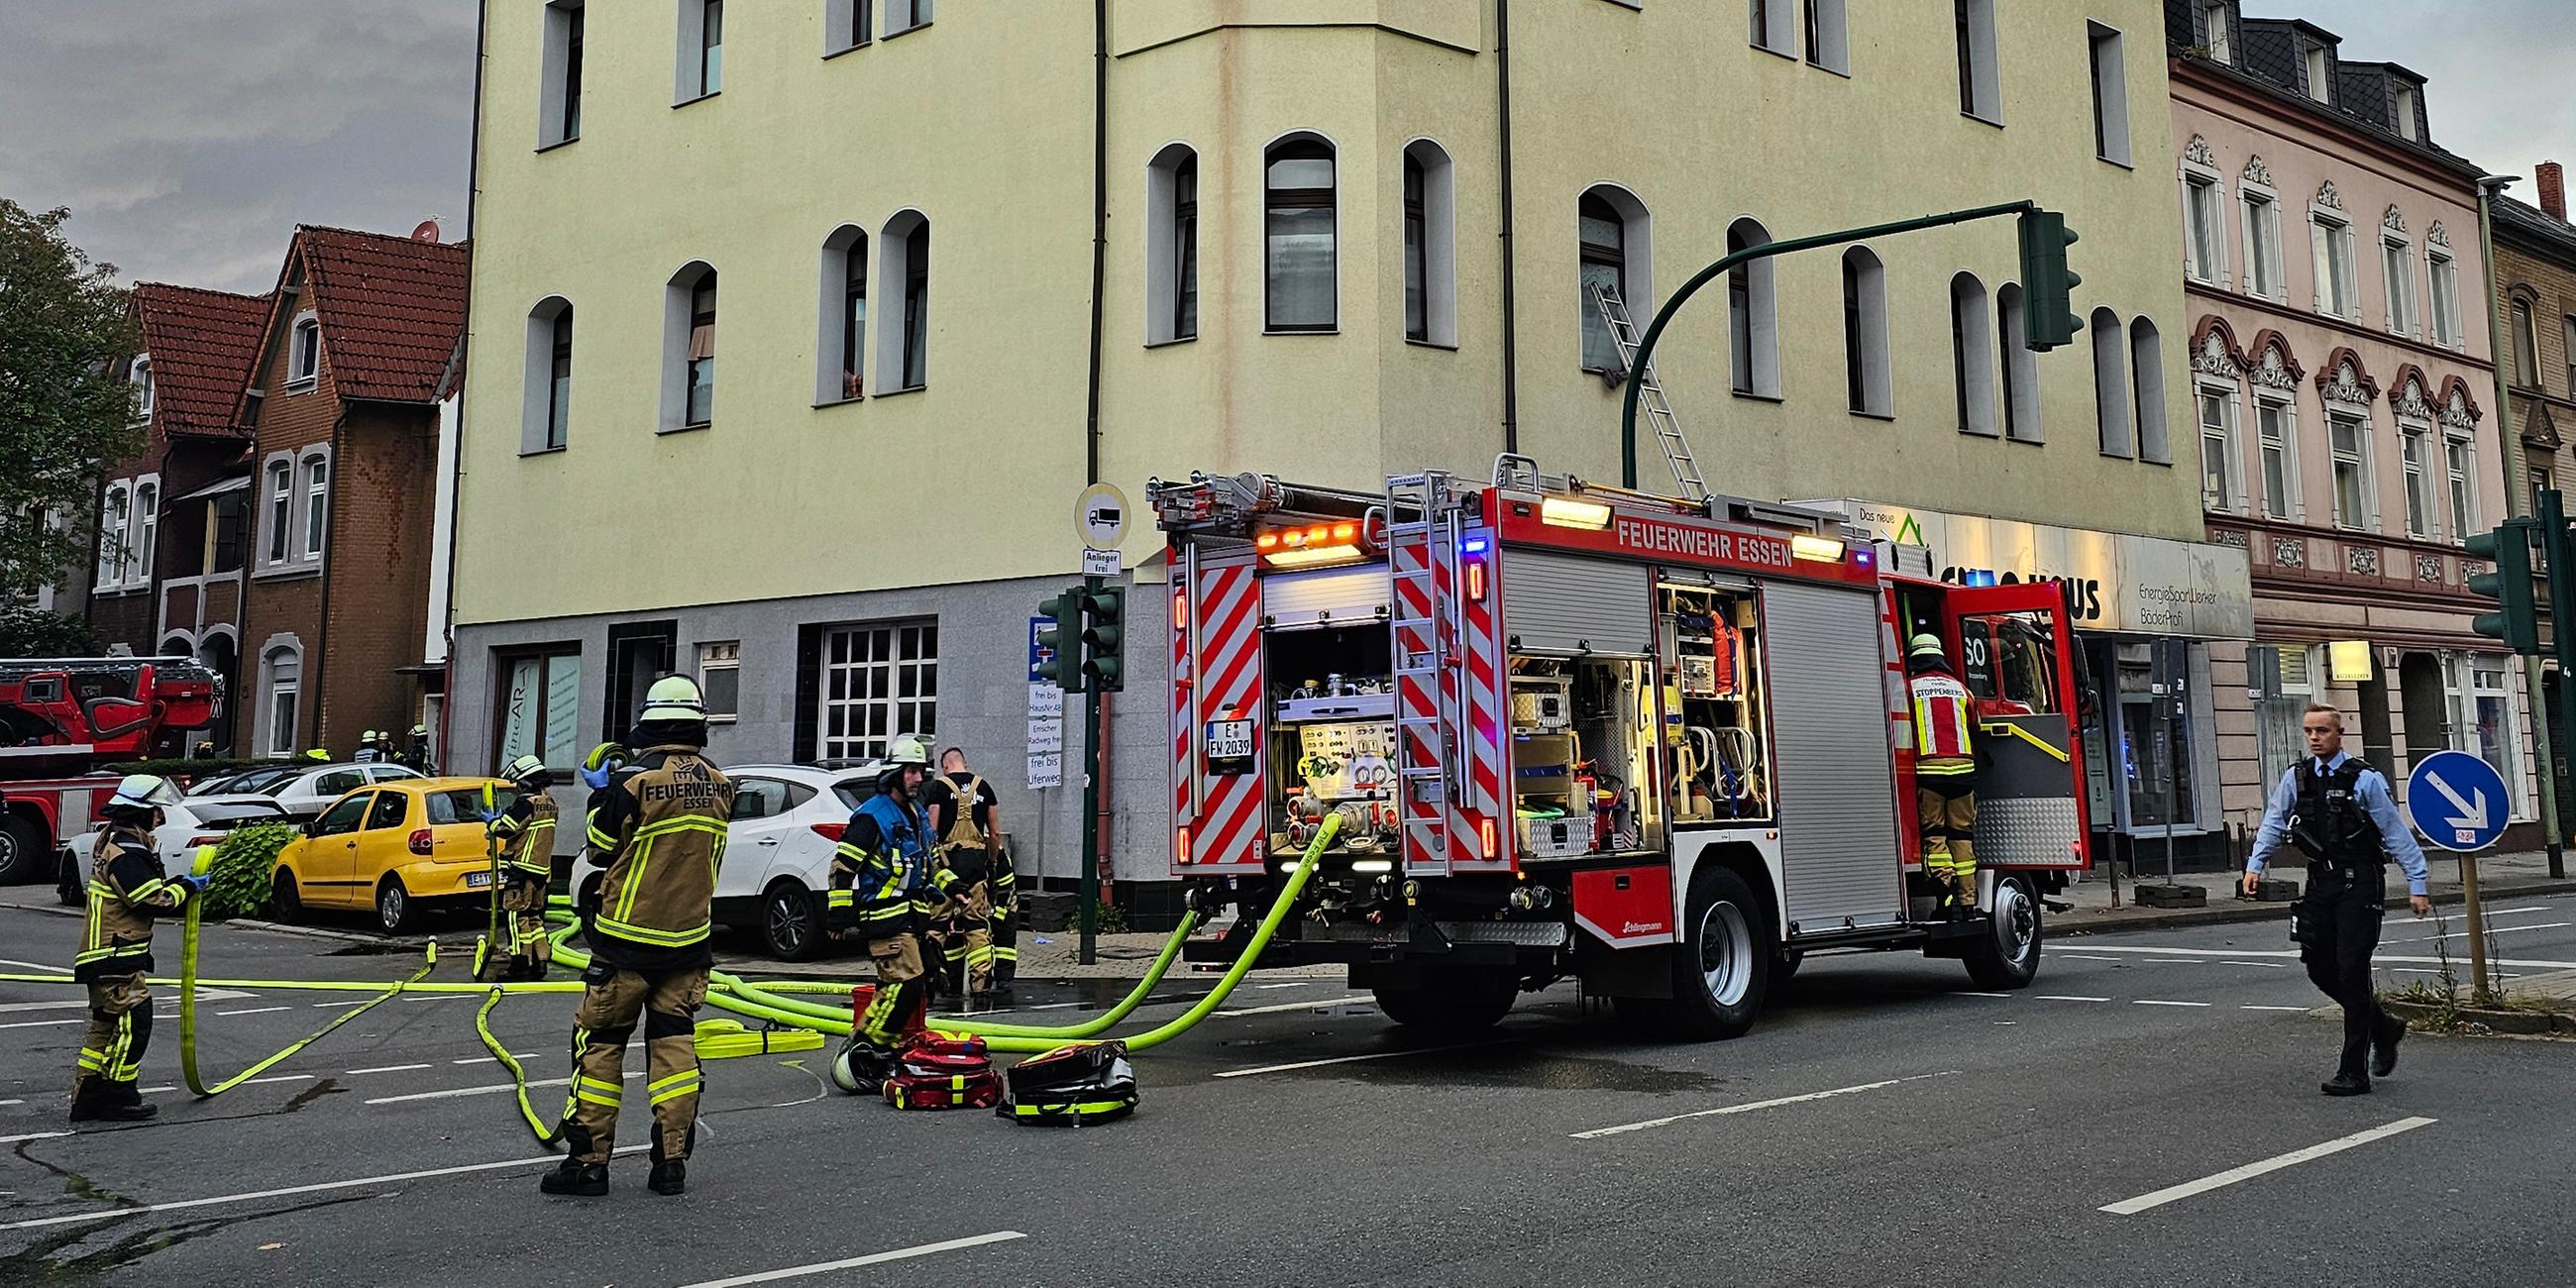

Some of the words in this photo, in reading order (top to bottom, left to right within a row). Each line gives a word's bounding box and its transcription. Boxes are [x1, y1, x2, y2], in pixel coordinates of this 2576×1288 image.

[1860, 507, 1875, 521] Das
[1877, 513, 1895, 524] neue
[1618, 520, 1733, 560] FEUERWEHR
[1738, 537, 1792, 568] ESSEN
[1086, 553, 1118, 564] Anlieger
[1095, 564, 1109, 573] frei
[1226, 723, 1232, 738] E
[1210, 740, 1224, 756] FW
[1225, 739, 1249, 755] 2039
[1031, 757, 1045, 768] frei
[1046, 756, 1058, 766] bis
[1027, 773, 1061, 786] Uferweg
[645, 782, 730, 802] FEUERWEHR
